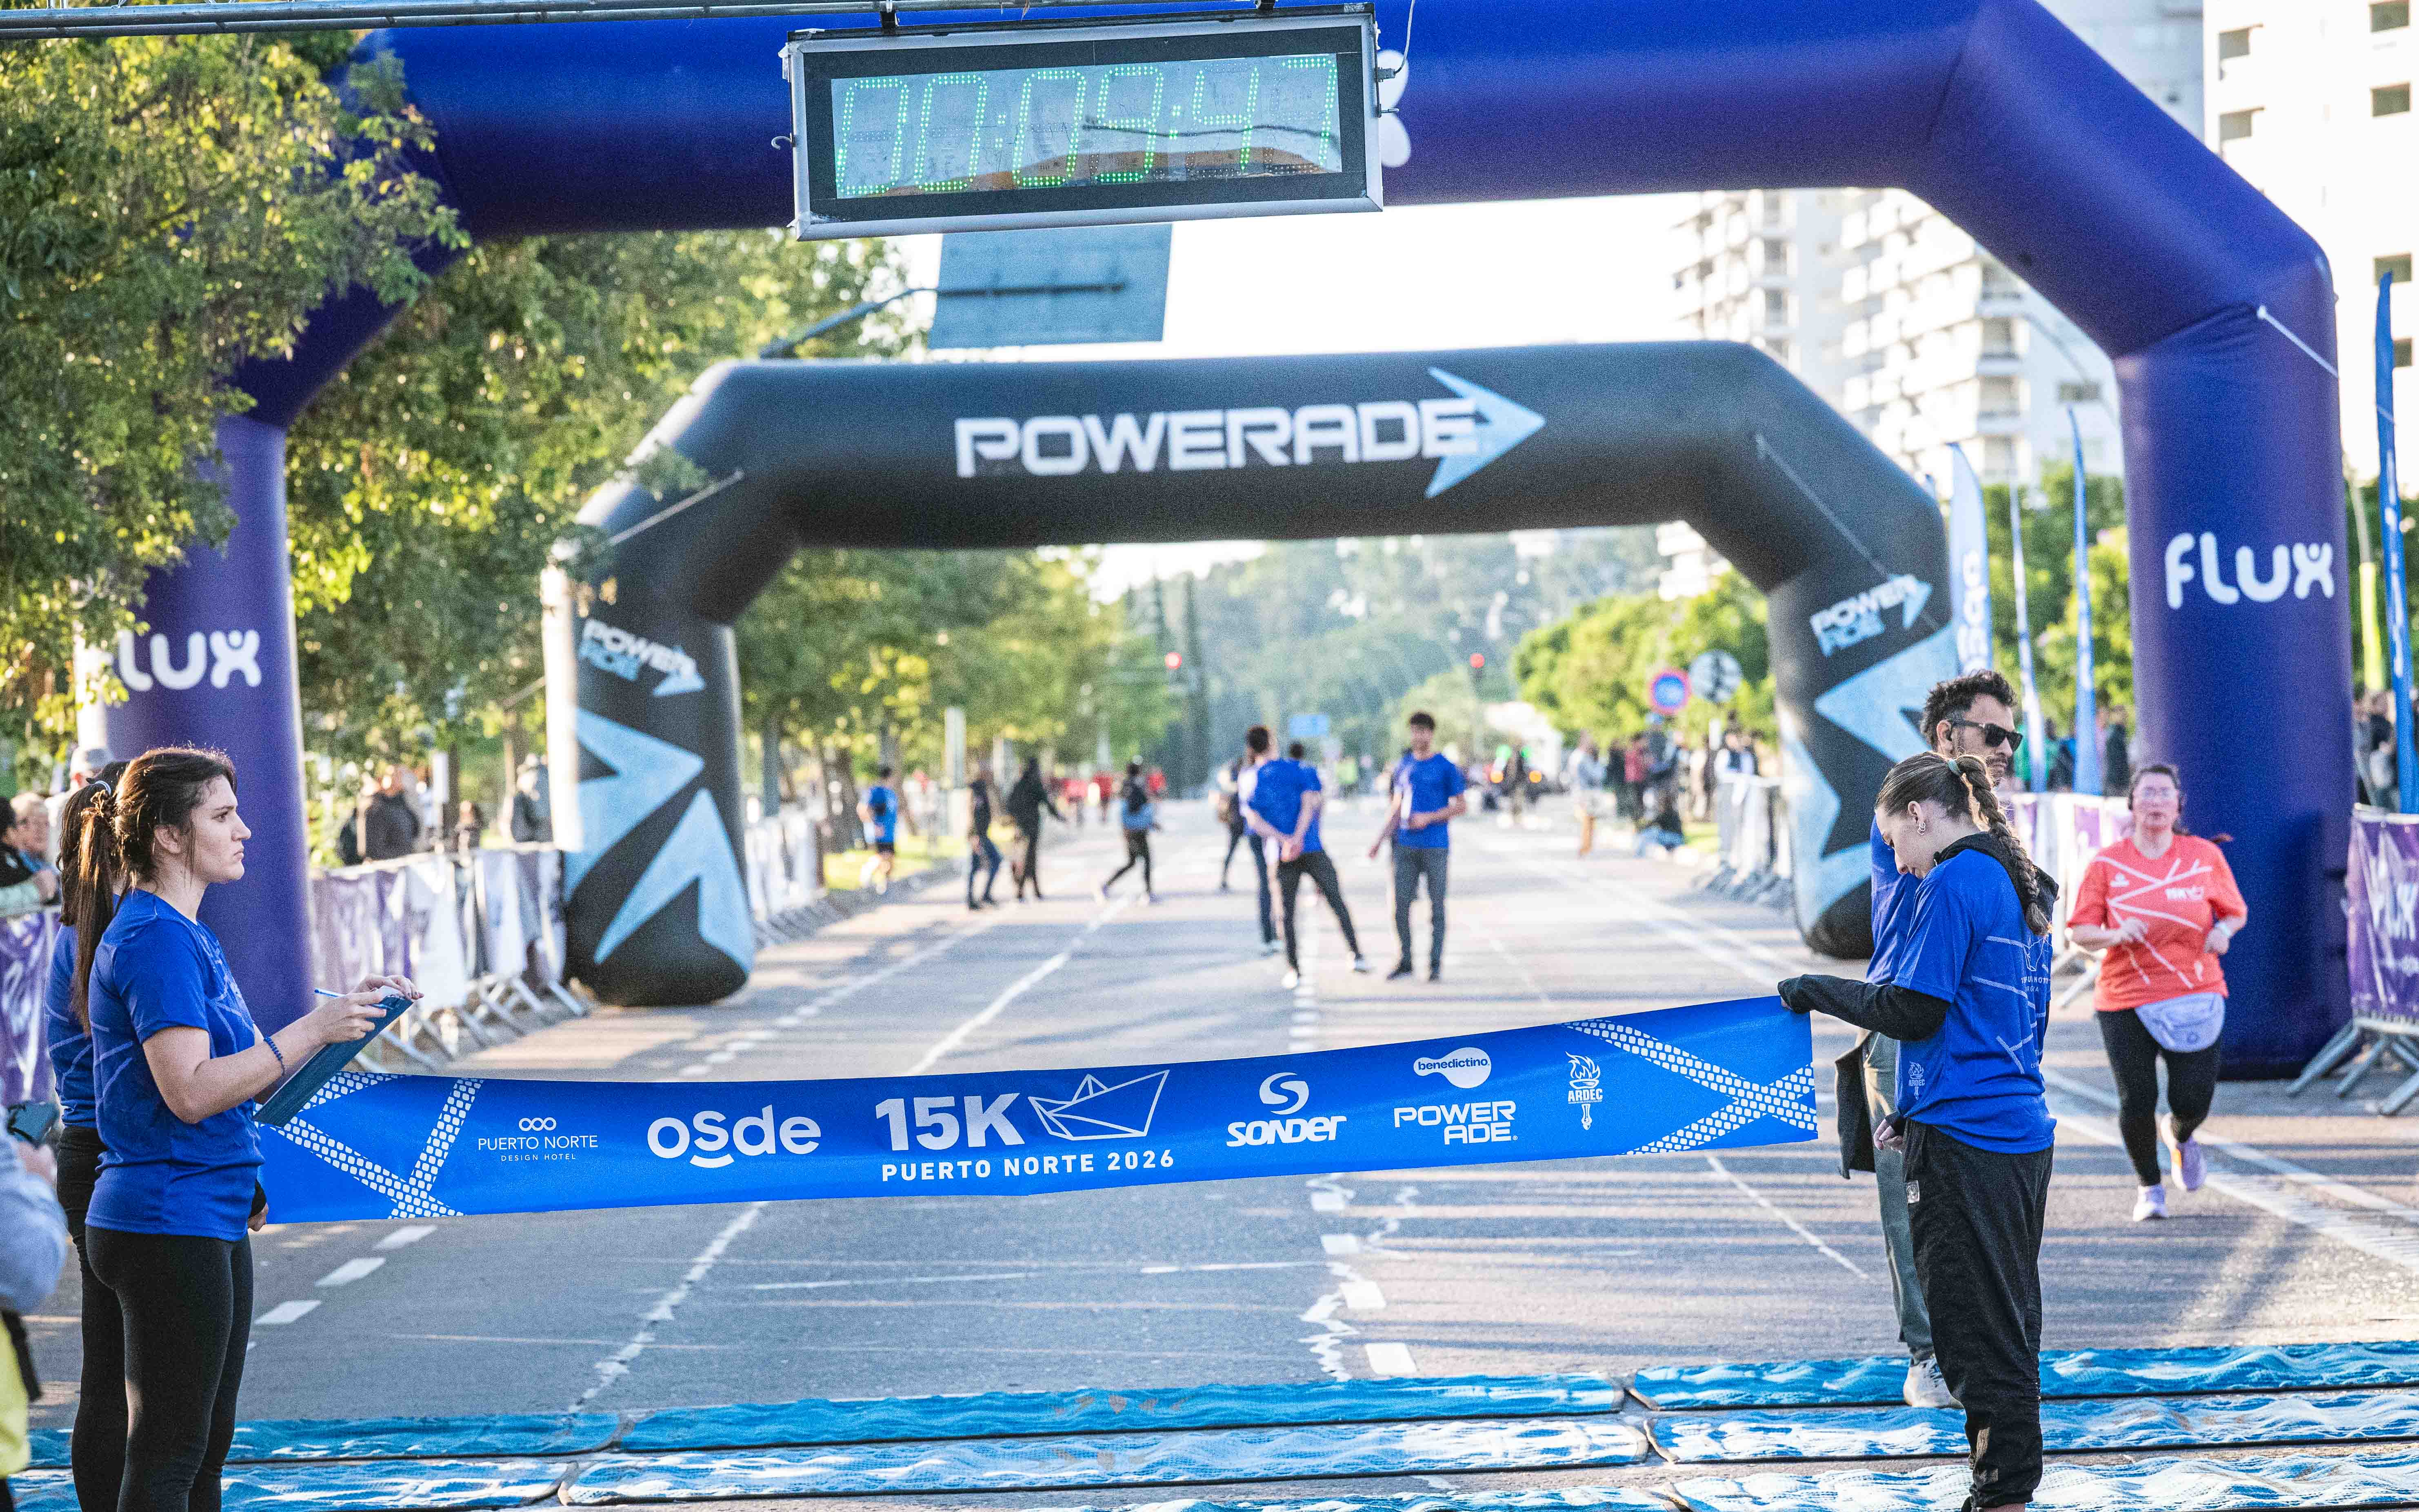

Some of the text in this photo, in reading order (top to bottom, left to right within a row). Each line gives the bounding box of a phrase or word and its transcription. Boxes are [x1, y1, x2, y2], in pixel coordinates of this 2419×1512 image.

[835, 54, 1338, 197] 00:09:47
[954, 398, 1478, 478] POWERADE
[2164, 531, 2335, 610] FLUX
[107, 629, 262, 691] LUX
[1418, 1058, 1488, 1070] benedictino
[1394, 1101, 1516, 1128] POWER
[1568, 1088, 1603, 1101] ARDEC
[478, 1135, 598, 1150] PUERTO NORTE
[875, 1092, 1025, 1150] 15K
[882, 1149, 1174, 1181] PUERTO NORTE 2026
